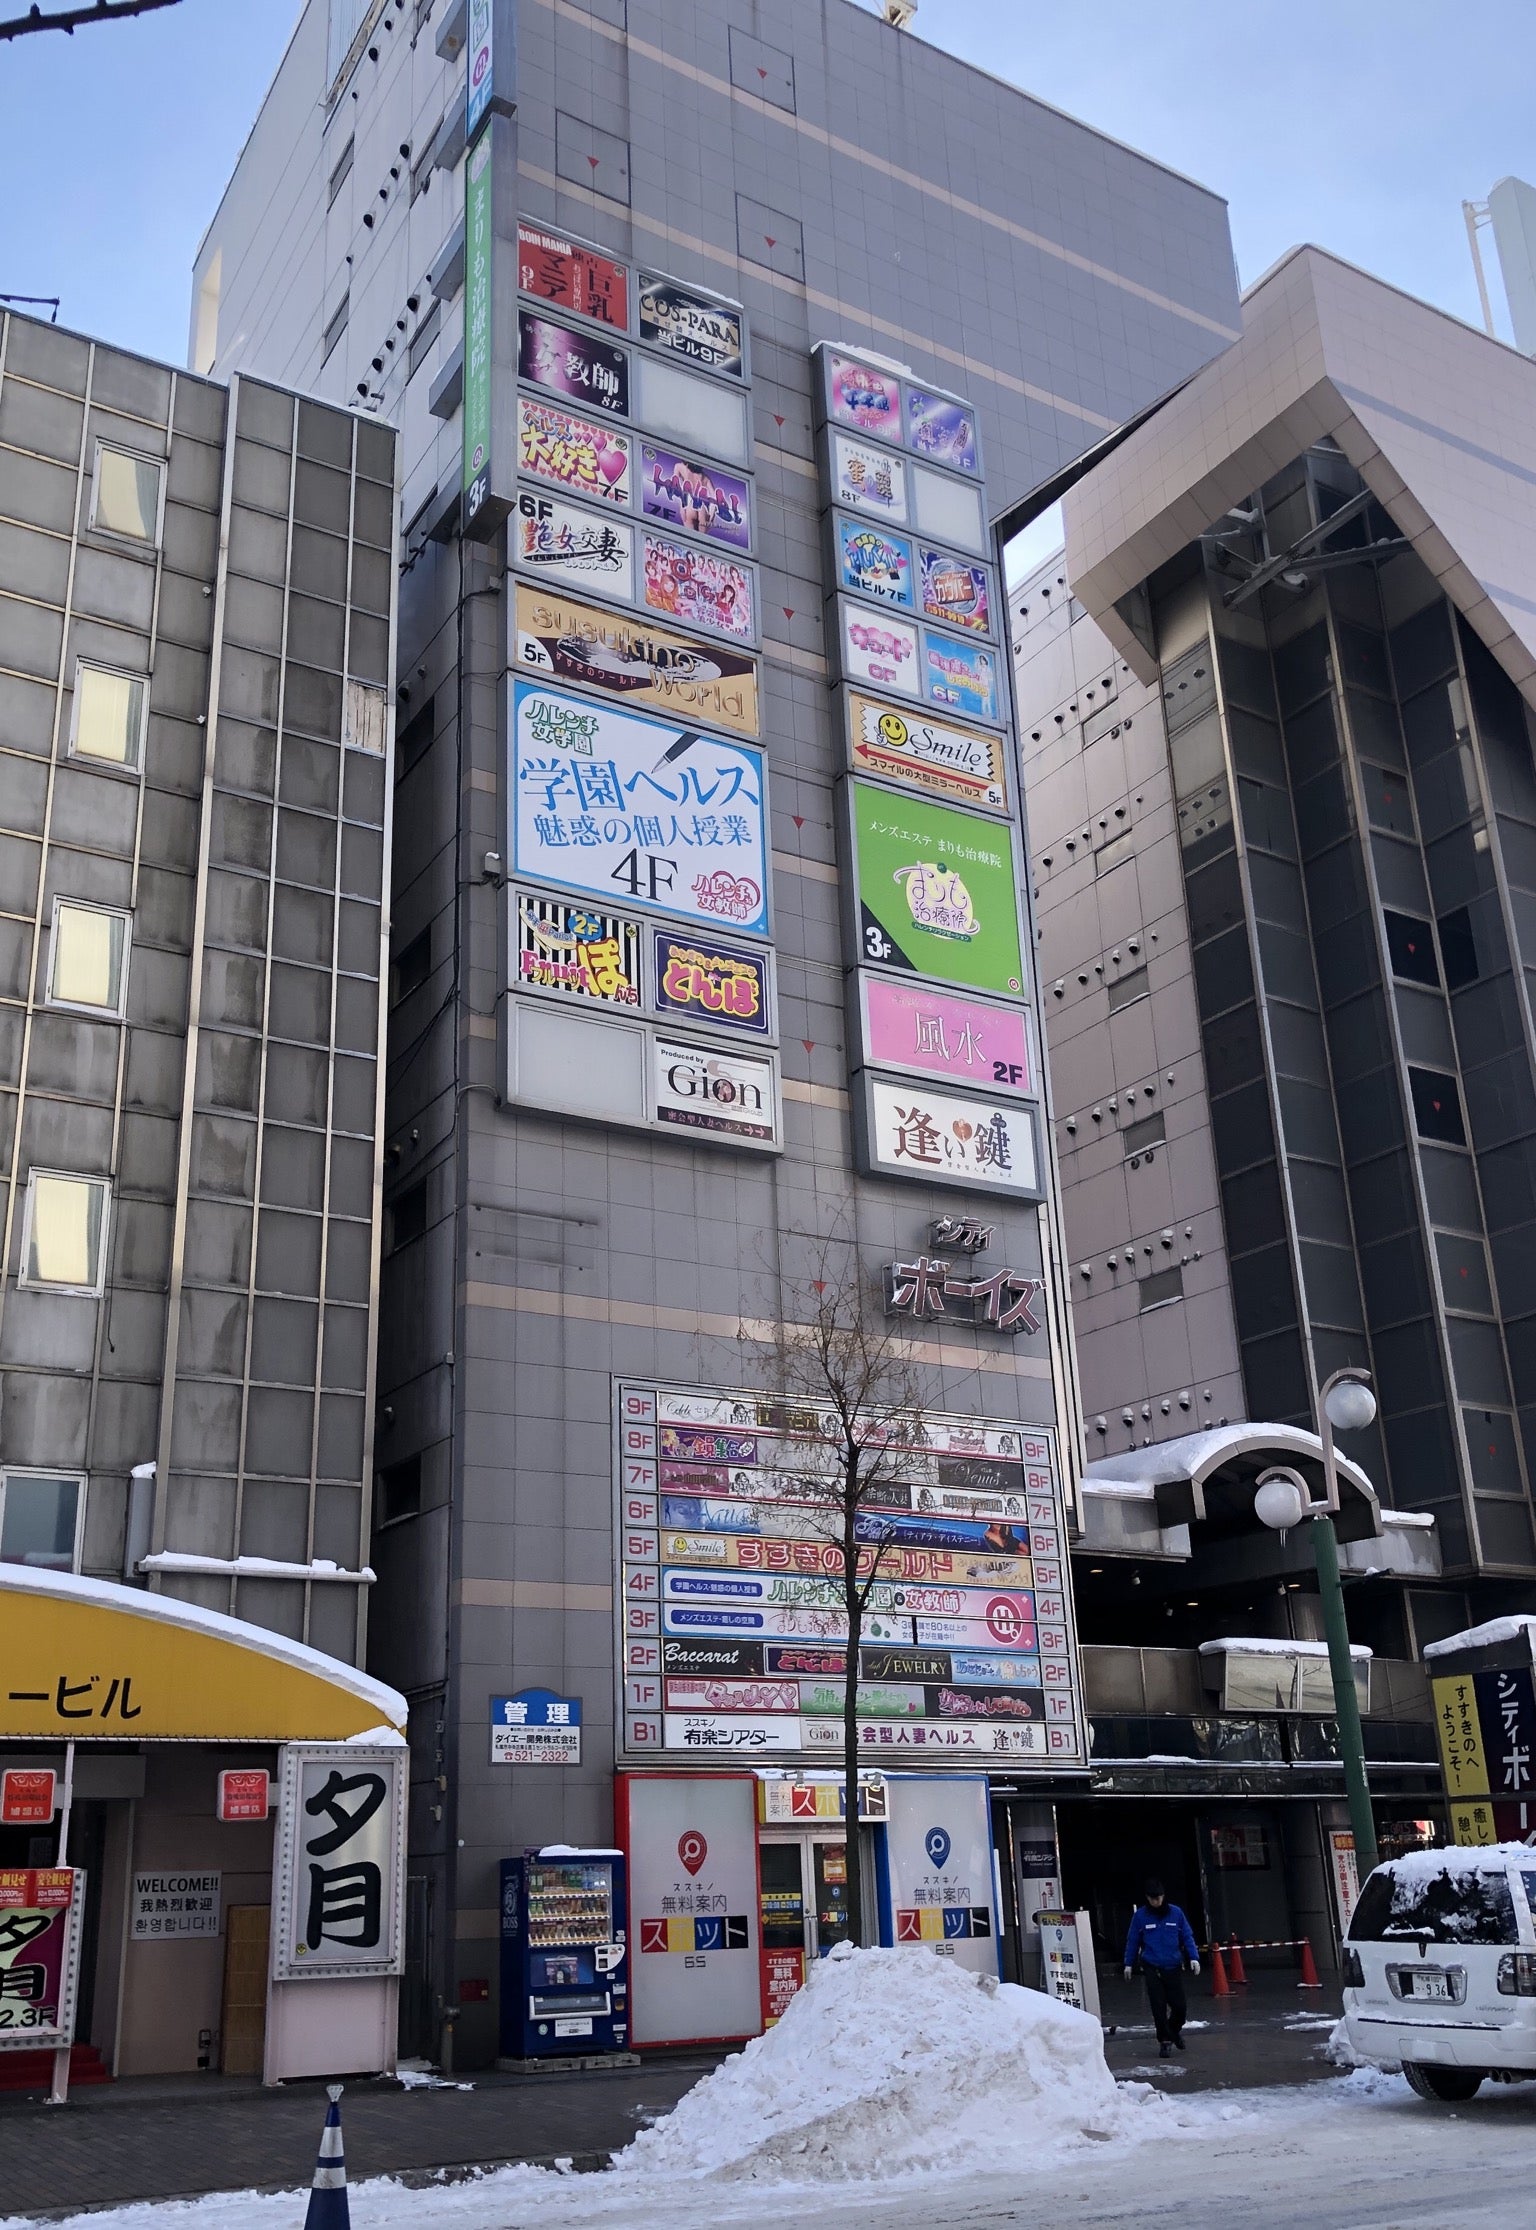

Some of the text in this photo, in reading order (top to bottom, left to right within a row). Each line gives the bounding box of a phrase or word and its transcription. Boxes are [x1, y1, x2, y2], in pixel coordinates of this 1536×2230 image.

[518, 229, 572, 256] BOIN MANIA
[521, 265, 535, 290] 9F
[540, 248, 568, 297] マニア
[640, 294, 740, 347] COS-PARA
[657, 329, 724, 364] 当ビル9F
[601, 396, 623, 410] 8F
[523, 409, 572, 441] ヘルス
[521, 423, 598, 485] 大好き
[469, 477, 487, 517] 3F
[599, 482, 628, 502] 7F
[841, 489, 860, 504] 8F
[519, 494, 552, 521] 6F
[647, 502, 676, 521] 7F
[849, 574, 907, 602] 当ビル7F
[935, 579, 972, 602] カウパー
[523, 642, 547, 664] 5F
[555, 652, 638, 687] すすきのワールド
[932, 684, 960, 705] 6F
[525, 699, 600, 735] ハレンチ
[532, 721, 594, 756] 女学園
[910, 728, 982, 766] Smile
[520, 757, 760, 812] 学園ヘルス
[870, 757, 982, 799] スマイルの大型ミラーヘルス
[988, 791, 1002, 805] 5F
[533, 814, 753, 848] 魅惑の個人授業
[870, 820, 1003, 868] メンズエステ まりも治療院
[610, 847, 679, 902] 4F
[691, 873, 753, 905] ハレンチ
[697, 893, 752, 920] 女教師
[573, 915, 599, 936] 2F
[866, 926, 892, 959] 3F
[521, 949, 590, 988] Fruit
[664, 960, 758, 1016] とんぼ
[914, 1010, 988, 1066] 風水
[660, 1049, 705, 1065] Produced by
[992, 1061, 1023, 1085] 2F
[667, 1064, 763, 1110] Gion
[892, 1105, 1013, 1171] 逢い鍵
[936, 1215, 997, 1249] シティ
[627, 1397, 652, 1416] 9F
[628, 1431, 653, 1450] 8F
[692, 1435, 740, 1459] 全員集合
[1024, 1442, 1045, 1458] 9F
[628, 1465, 653, 1484] 7F
[1028, 1473, 1049, 1489] 8F
[628, 1501, 653, 1520] 6F
[1030, 1504, 1051, 1520] 7F
[628, 1536, 654, 1555] 5F
[688, 1539, 722, 1553] Smile
[1033, 1534, 1055, 1551] 6F
[629, 1573, 655, 1591] 4F
[1036, 1567, 1057, 1584] 5F
[906, 1589, 961, 1614] 女教師
[1039, 1602, 1061, 1617] 4F
[629, 1609, 655, 1628] 3F
[1042, 1631, 1063, 1648] 3F
[630, 1646, 657, 1665] 2F
[664, 1642, 739, 1664] Baccarat
[879, 1653, 948, 1679] JEWELRY
[1045, 1664, 1067, 1681] 2F
[7, 1675, 142, 1720] ービル
[633, 1683, 655, 1702] 1F
[504, 1701, 570, 1724] 管理
[1050, 1697, 1067, 1714] 1F
[634, 1722, 656, 1742] B1
[684, 1718, 716, 1727] ススキノ
[1456, 1685, 1480, 1768] すすきのへ
[495, 1734, 578, 1745] ダイエー開発株式会社
[684, 1729, 780, 1745] 有楽シアター
[809, 1727, 839, 1741] Gion
[857, 1726, 976, 1745] 会型人妻ヘルス
[993, 1725, 1034, 1750] 逢い鍵
[1051, 1731, 1070, 1748] B1
[514, 1750, 569, 1762] 521-2322
[1443, 1705, 1461, 1788] ようこそ!
[305, 1770, 387, 1951] 夕月
[136, 1876, 219, 1893] WELCOME!!
[673, 1882, 714, 1892] ススキノ
[923, 1876, 959, 1885] ススキノ
[661, 1893, 728, 1914] 無料案内
[914, 1887, 971, 1905] 無料案内
[135, 1916, 217, 1933] 환영합니다!!
[503, 1916, 519, 1929] BOSS
[773, 1967, 793, 1980] 無料
[769, 1979, 798, 1992] 案内所
[1055, 1982, 1075, 1996] 無料
